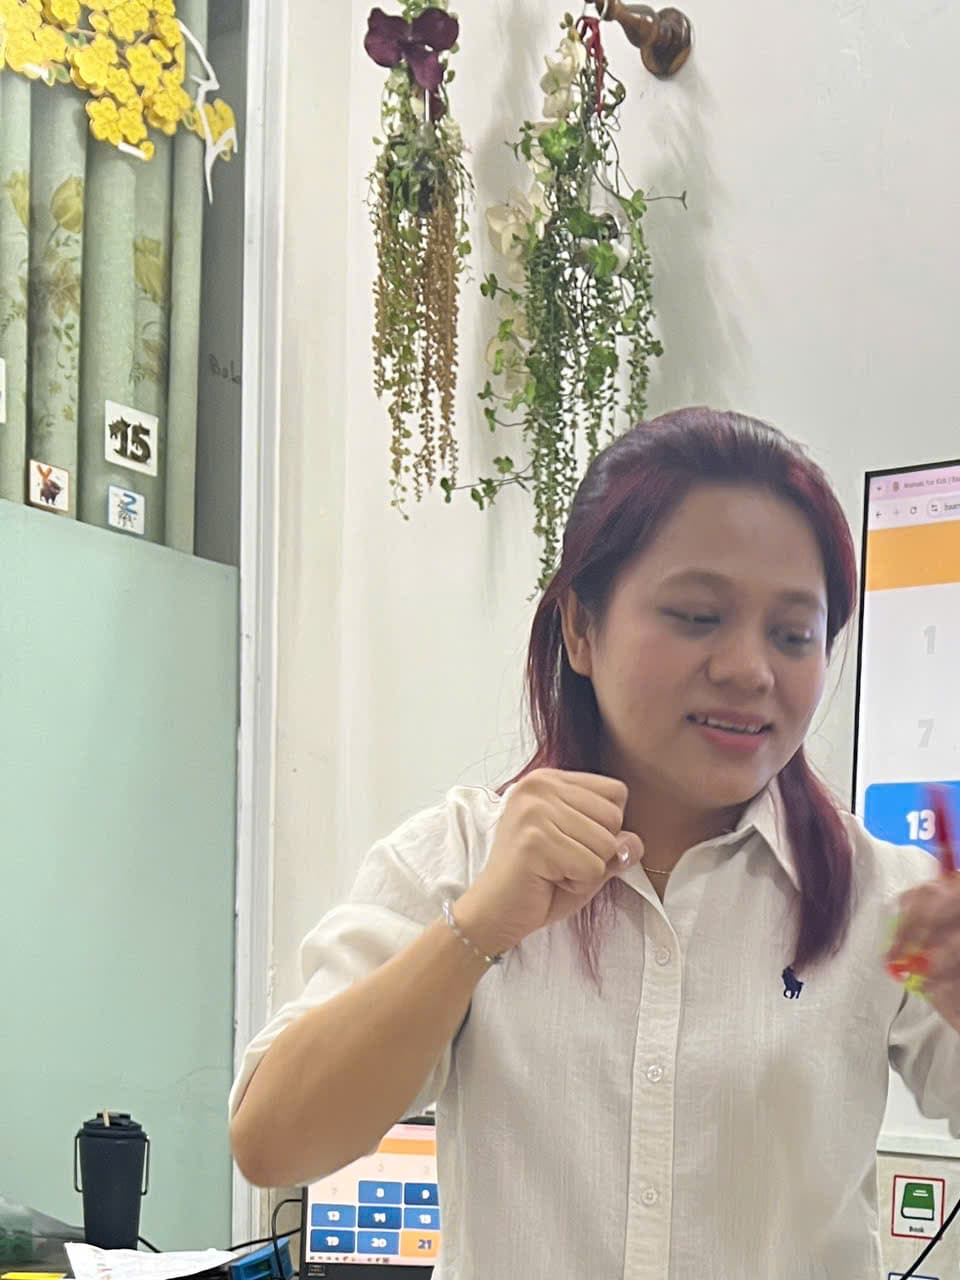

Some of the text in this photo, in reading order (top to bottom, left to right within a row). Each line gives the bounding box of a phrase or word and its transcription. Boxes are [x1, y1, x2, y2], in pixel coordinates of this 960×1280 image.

[923, 625, 936, 655] 1
[917, 718, 934, 748] 7
[906, 810, 936, 841] 13
[417, 1239, 433, 1250] 21
